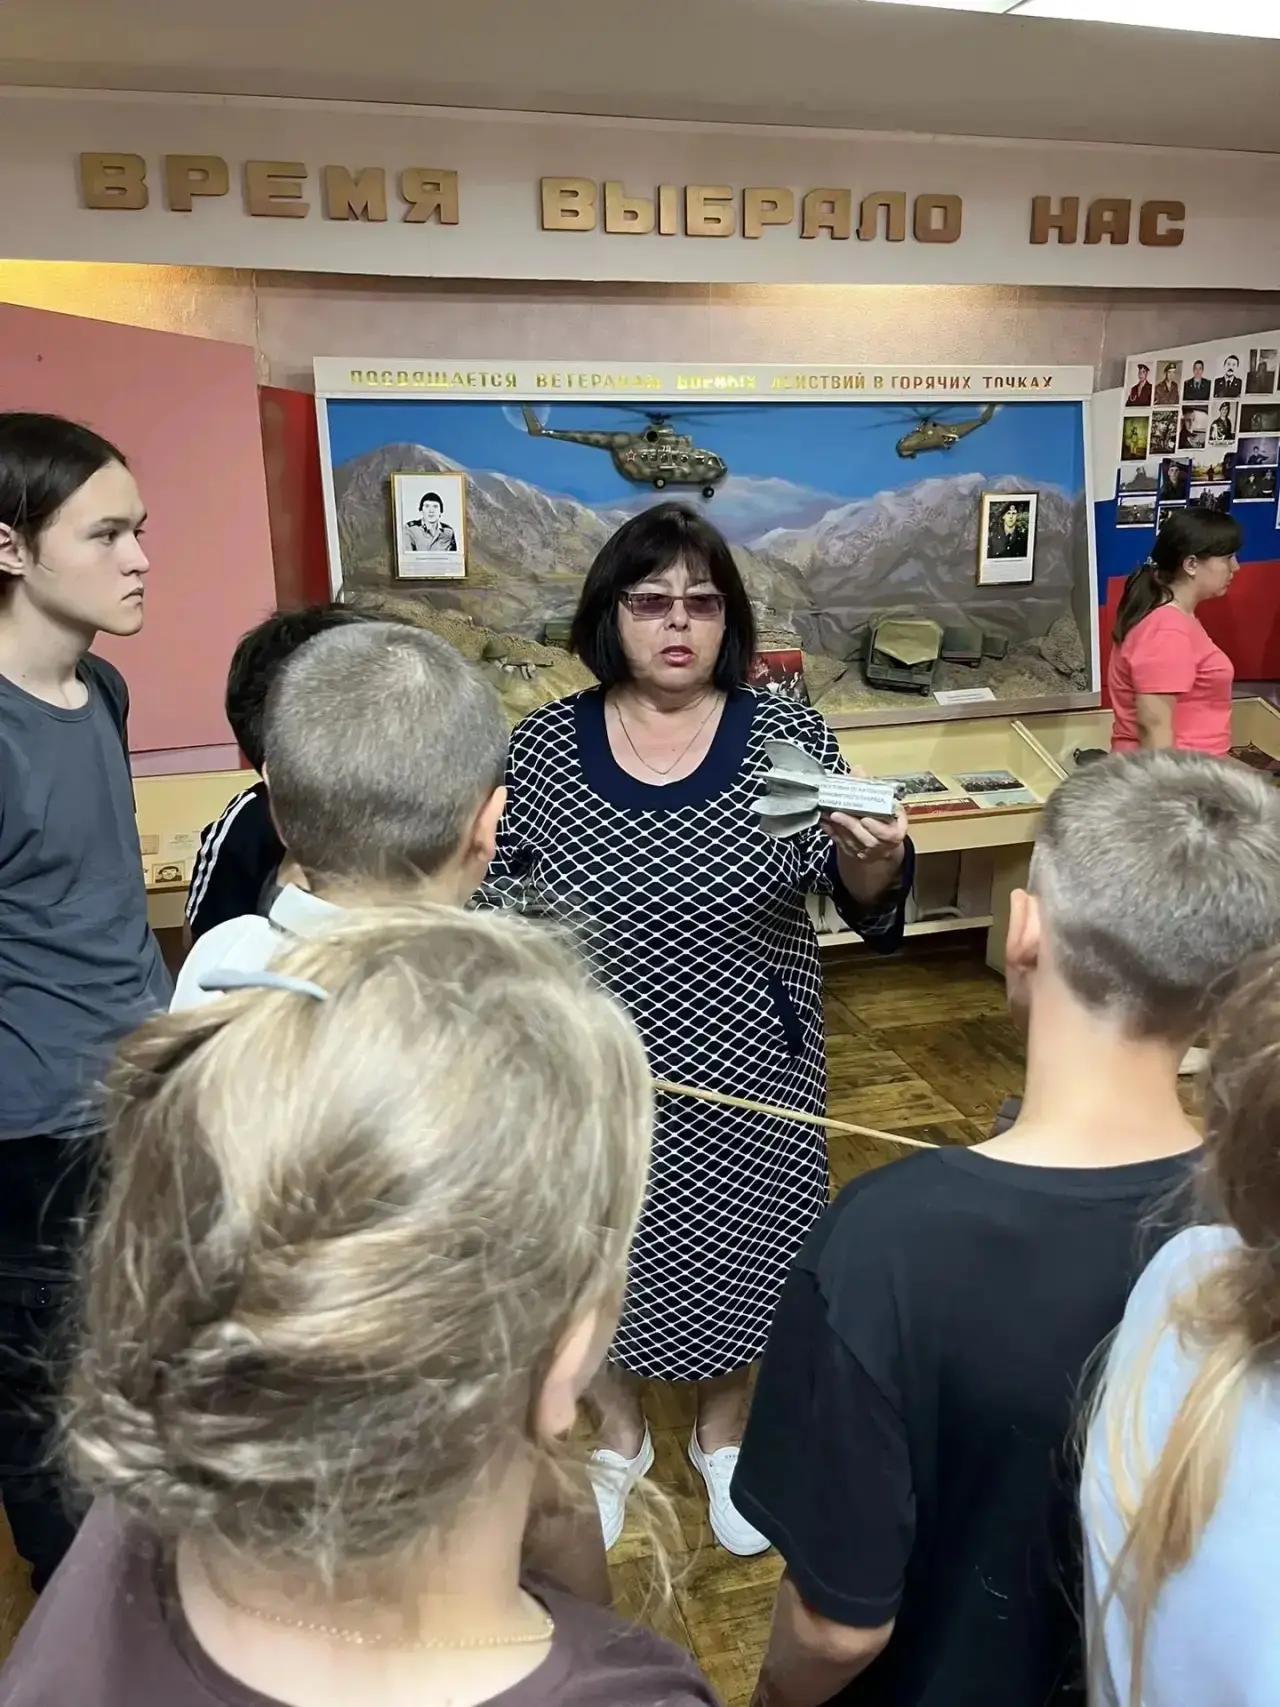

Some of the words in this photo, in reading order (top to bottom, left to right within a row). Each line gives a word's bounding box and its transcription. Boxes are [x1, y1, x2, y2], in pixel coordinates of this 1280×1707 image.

[80, 152, 459, 225] ВРЕМЯ
[540, 176, 963, 244] ВЫБРАЛО
[1029, 196, 1186, 247] НАС
[350, 370, 517, 388] ПОСВЯЩАЕТСЯ
[873, 375, 884, 390] В
[891, 375, 971, 390] ГОРЯЧИХ
[982, 376, 1053, 389] ТОЧКАХ
